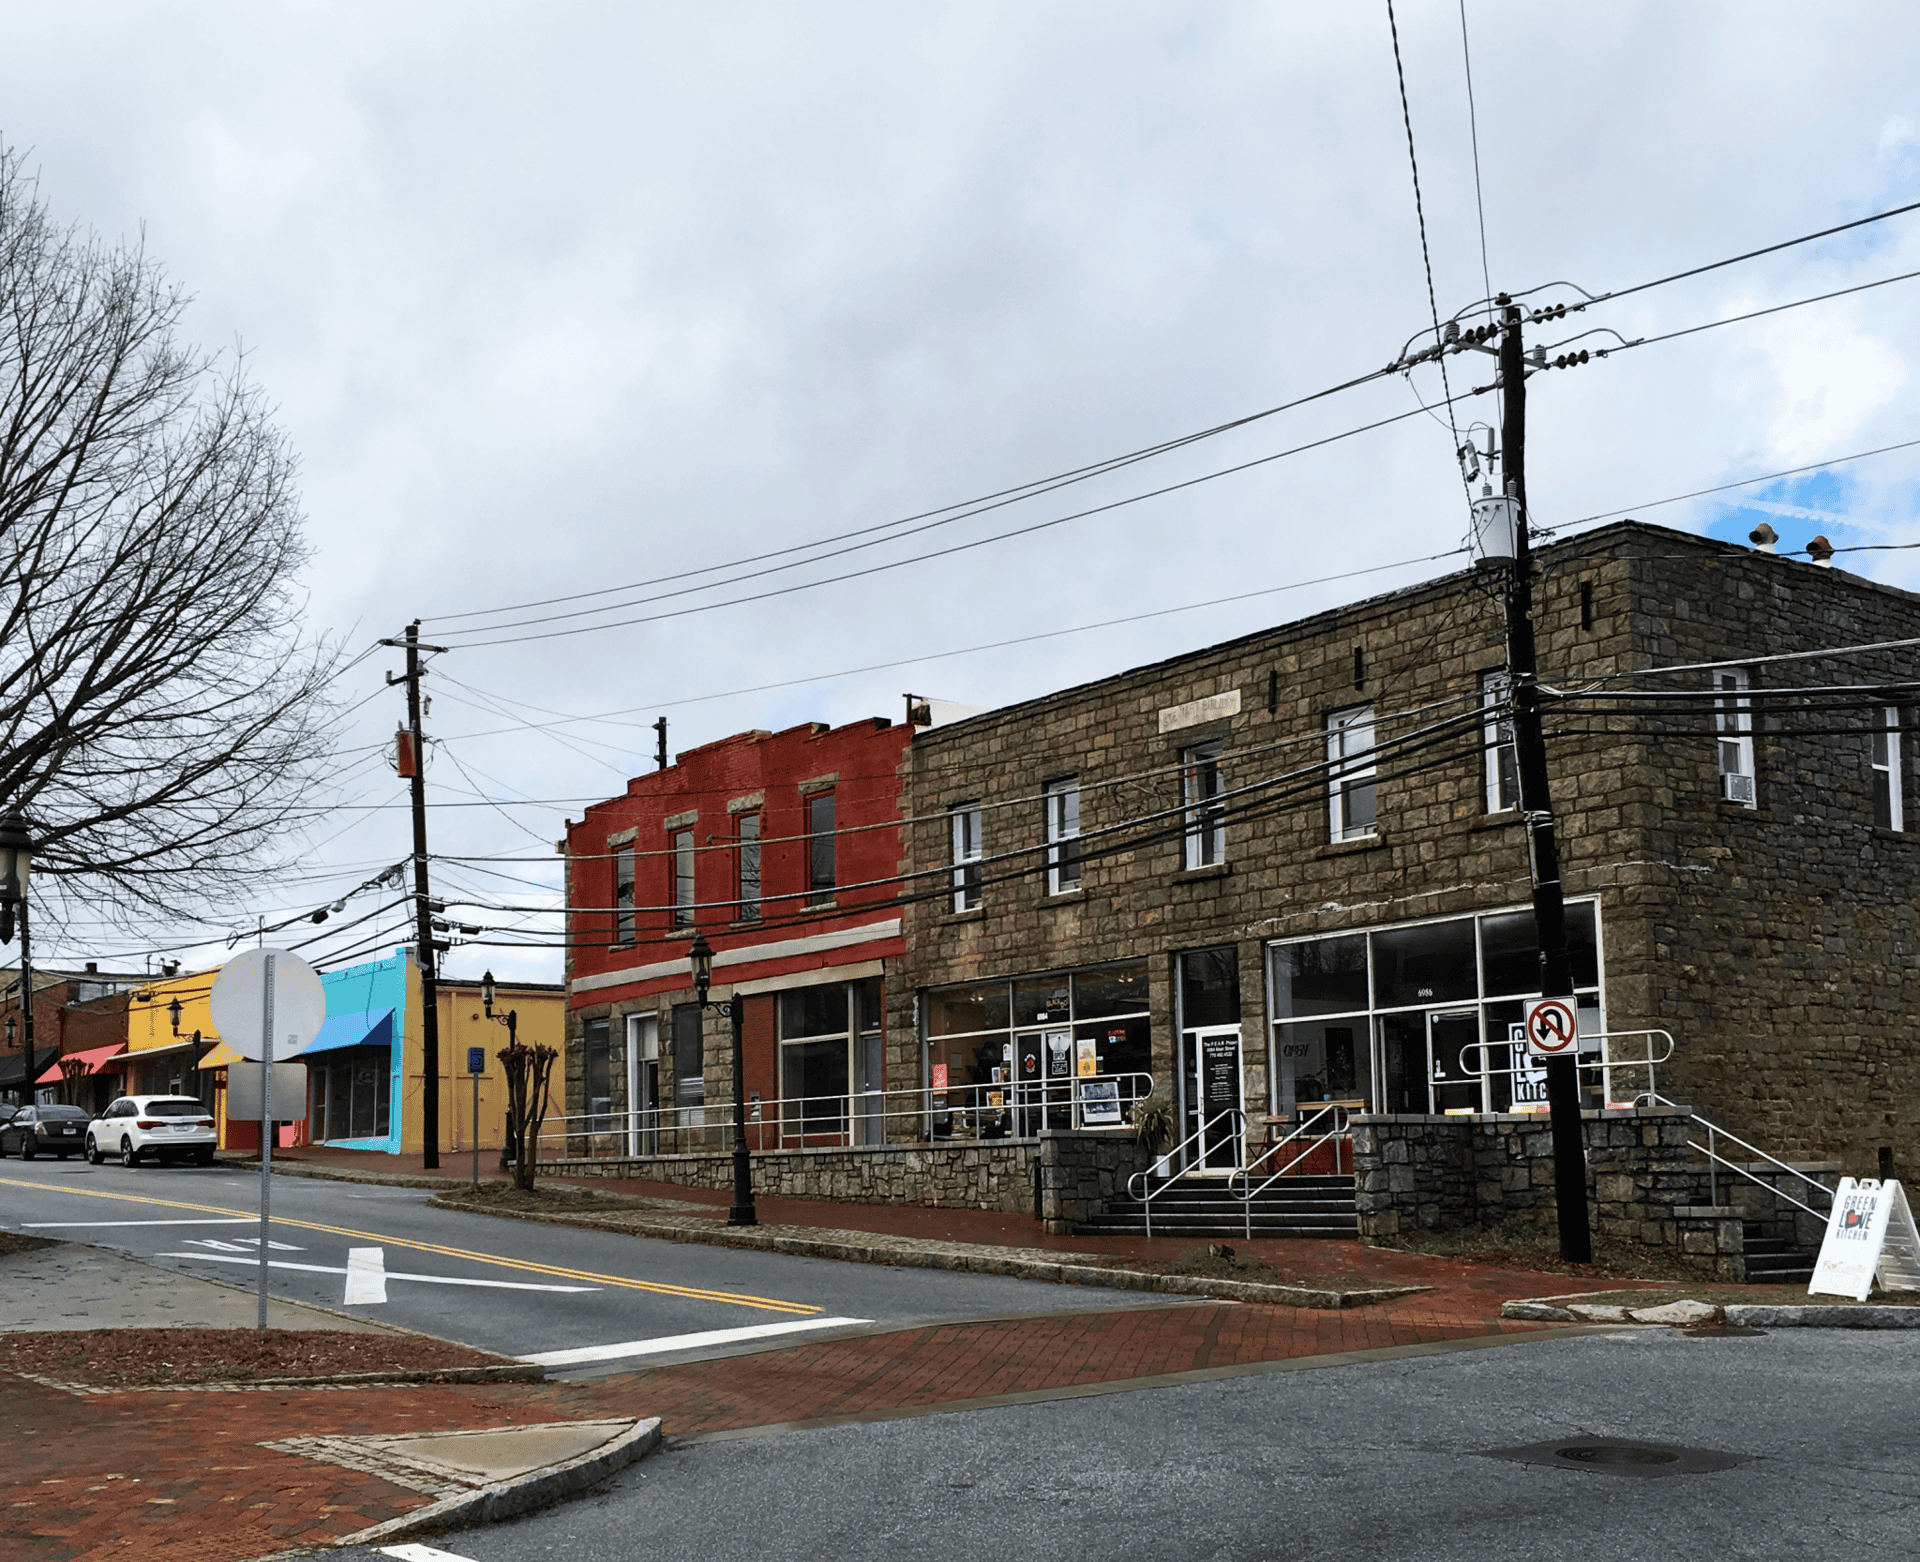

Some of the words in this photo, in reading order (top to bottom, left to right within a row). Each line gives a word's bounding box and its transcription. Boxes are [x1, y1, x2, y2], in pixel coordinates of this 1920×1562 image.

[1418, 988, 1433, 997] 6986
[1517, 1082, 1547, 1100] KITC
[1844, 1195, 1878, 1211] GREEN
[1835, 1229, 1869, 1241] KITCHEN
